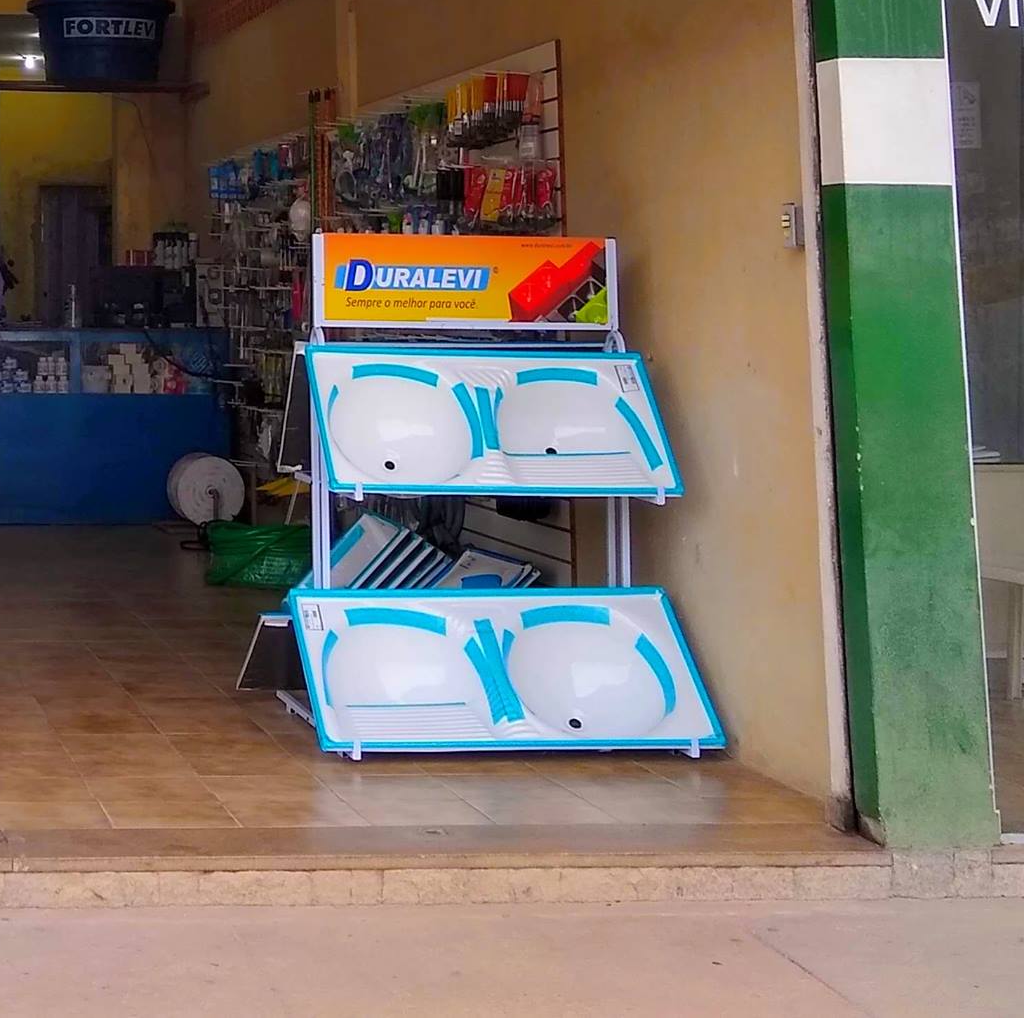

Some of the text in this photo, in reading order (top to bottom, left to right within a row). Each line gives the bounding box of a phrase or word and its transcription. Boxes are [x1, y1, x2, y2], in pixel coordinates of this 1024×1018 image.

[65, 19, 155, 37] FORTLEV
[344, 258, 482, 291] DURALEVI
[345, 296, 382, 310] Sempre
[384, 300, 391, 308] o
[393, 297, 427, 308] melhor
[429, 300, 452, 311] para
